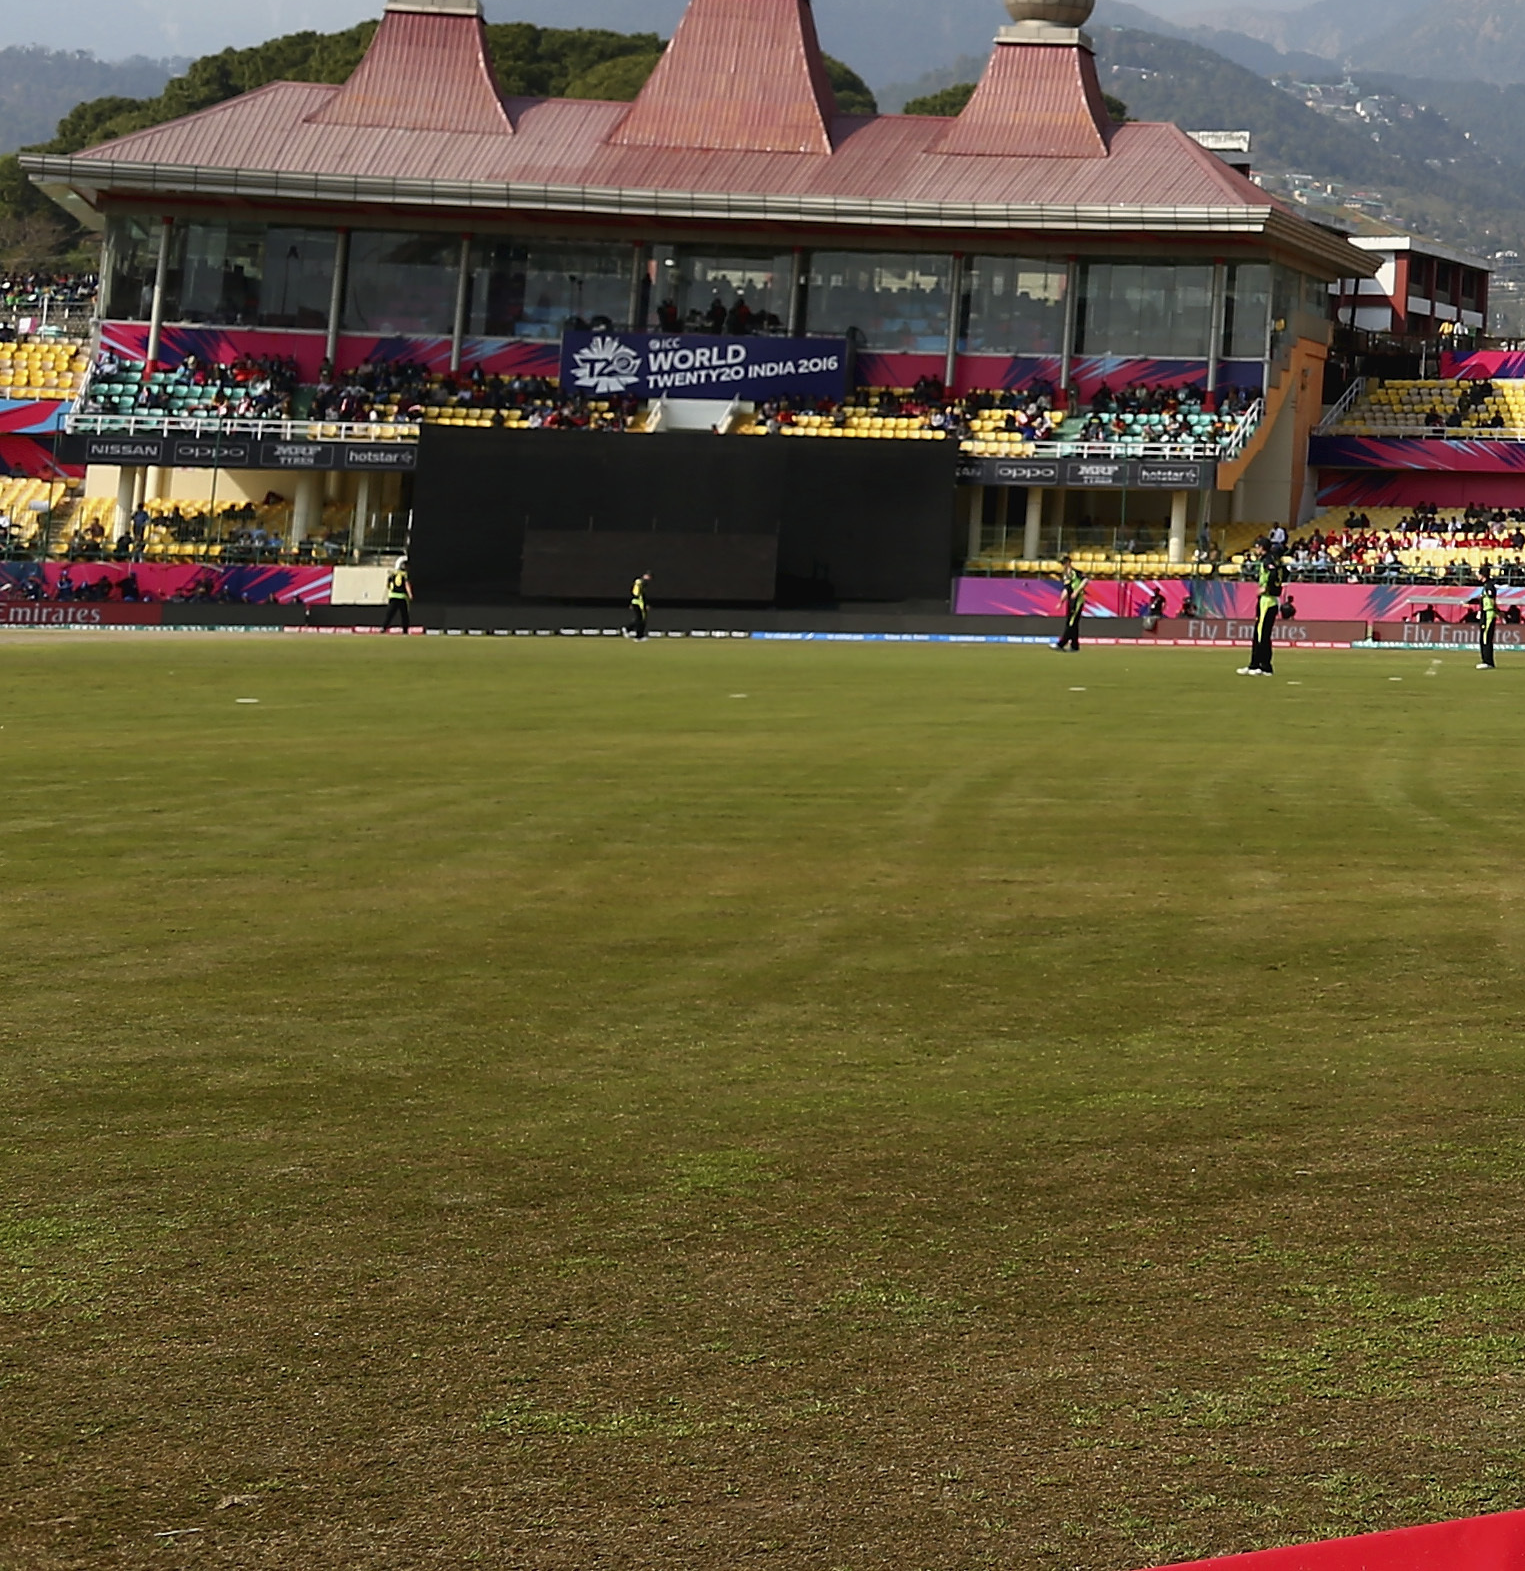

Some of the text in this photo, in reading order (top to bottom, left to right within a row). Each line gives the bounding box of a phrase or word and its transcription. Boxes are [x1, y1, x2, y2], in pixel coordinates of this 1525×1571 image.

[661, 337, 680, 349] ICC
[650, 345, 746, 372] WORLD
[647, 356, 838, 389] TWENTY20 INDIA 2016
[91, 445, 158, 456] NISSAN
[178, 446, 245, 458] oppo
[350, 450, 399, 463] hotstar
[999, 467, 1054, 478] oppo
[1142, 470, 1184, 482] hotstar
[1226, 621, 1306, 641] Emates
[1440, 625, 1521, 645] Emites
